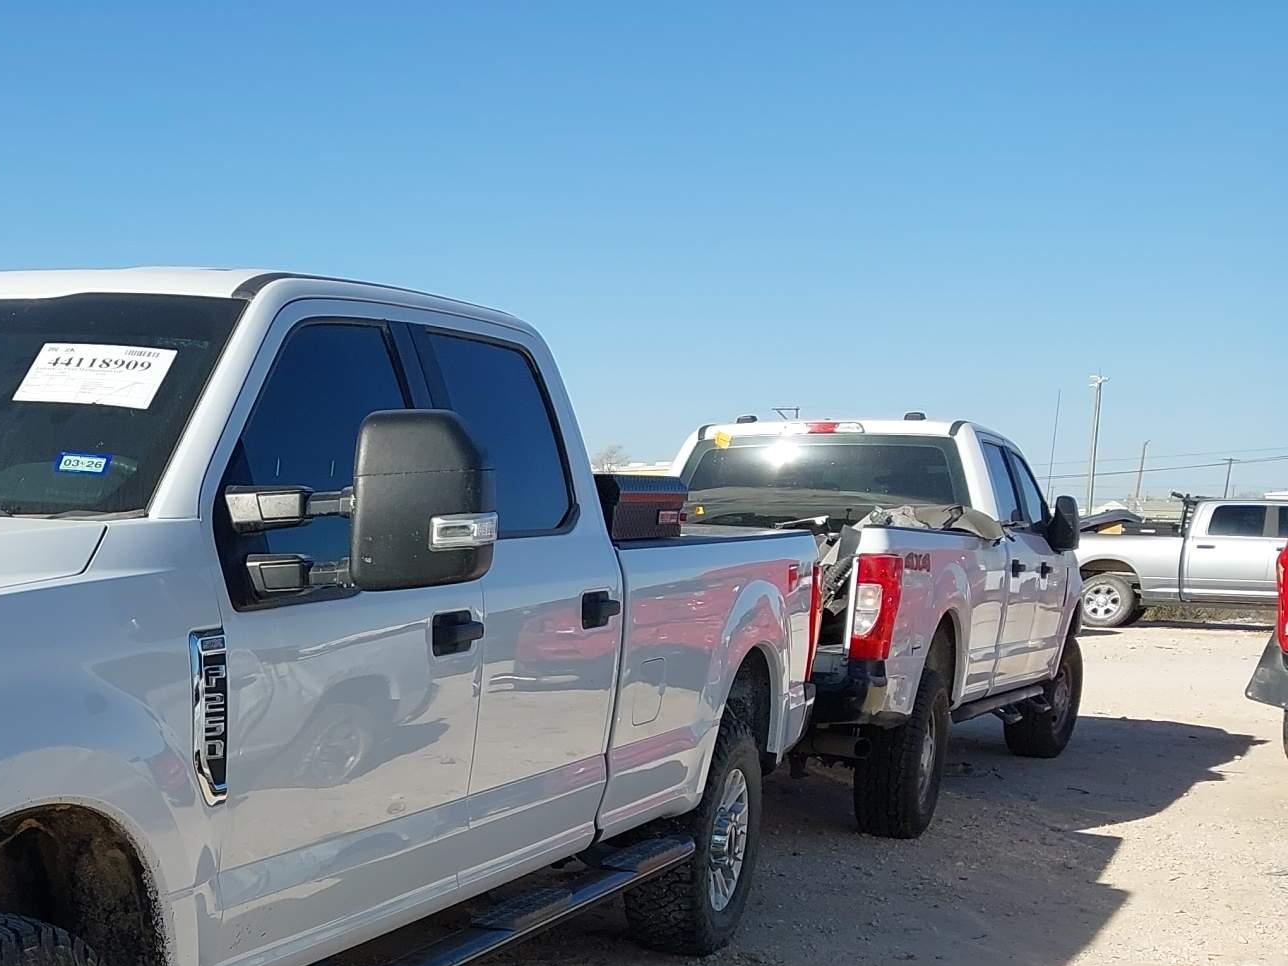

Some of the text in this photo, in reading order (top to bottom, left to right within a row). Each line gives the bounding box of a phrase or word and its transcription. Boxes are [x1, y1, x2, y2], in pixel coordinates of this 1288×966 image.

[47, 356, 152, 372] 44118909
[63, 459, 103, 469] 03 26
[904, 552, 930, 572] 4X4
